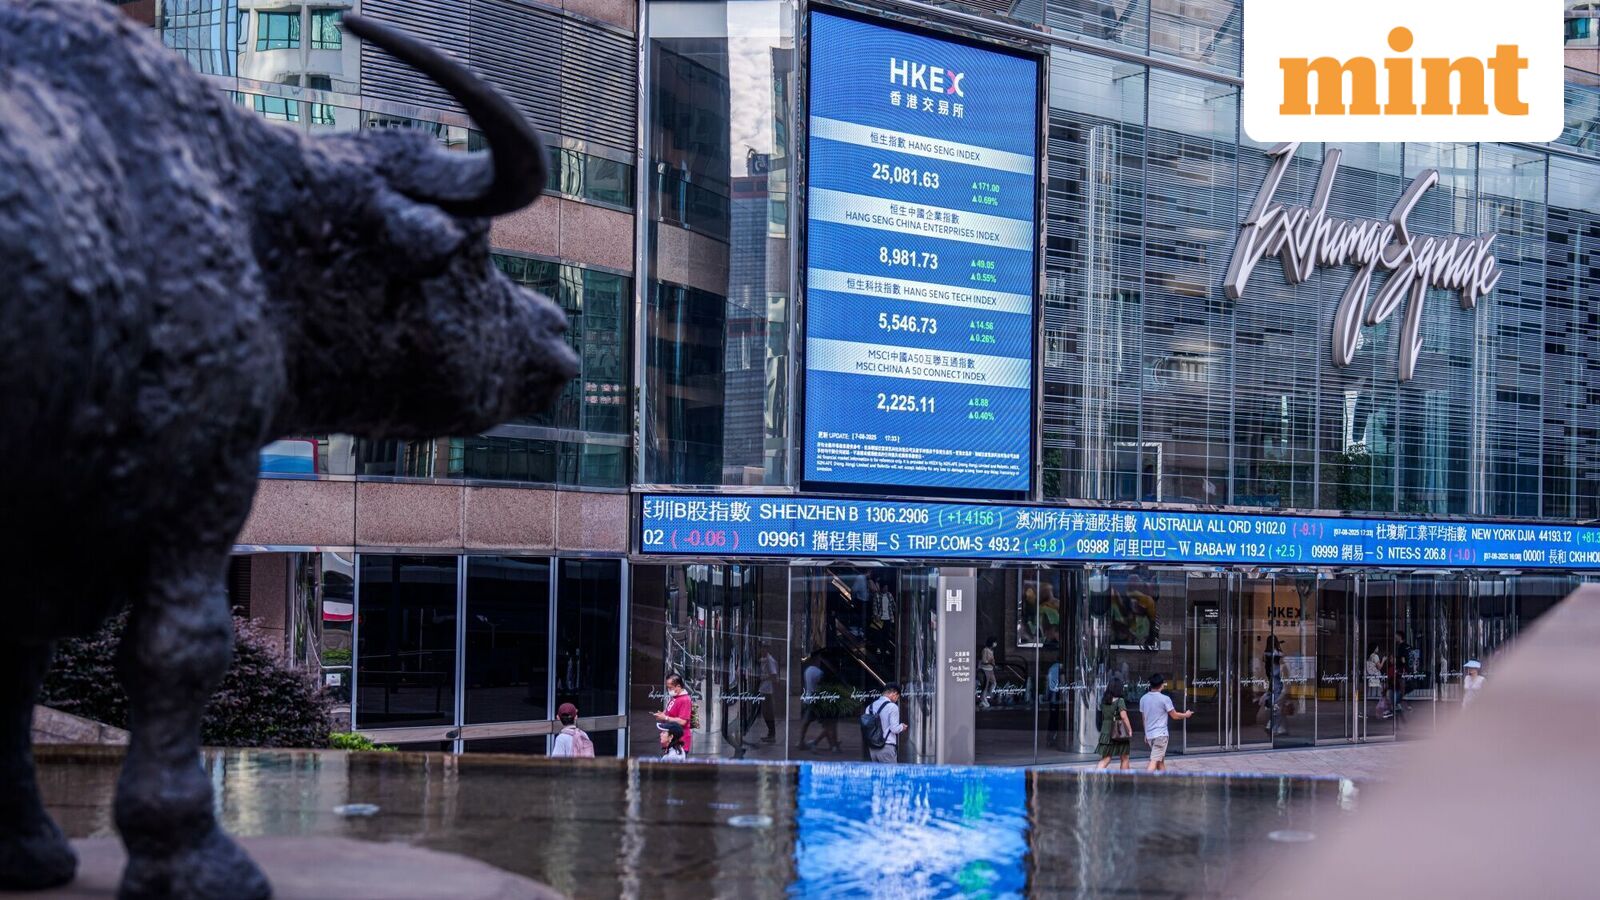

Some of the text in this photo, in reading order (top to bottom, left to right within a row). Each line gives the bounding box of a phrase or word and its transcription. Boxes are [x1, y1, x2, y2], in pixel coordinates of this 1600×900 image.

[890, 58, 964, 97] HKEX
[890, 91, 964, 119] 香港交易所
[870, 131, 981, 161] 恒生指數 HANG SENG INDEX
[872, 162, 940, 189] 25,081.63
[846, 210, 1000, 242] HANG SENG CHINA ENTERPRISES INDEX
[880, 247, 939, 270] 8,981.73
[1364, 168, 1502, 381] Square
[904, 286, 928, 298] HANG
[929, 289, 950, 300] SENG
[952, 292, 972, 304] TECH
[974, 295, 997, 306] INDEX
[878, 312, 938, 335] 5,546.73
[856, 362, 986, 381] MSCI CHINA A 50 CONNECT INDEX
[877, 393, 935, 413] 2,225.11
[760, 504, 846, 521] SHENZHEN
[850, 506, 859, 521] B
[866, 507, 929, 524] 1306.2906
[1016, 510, 1137, 533] 澳洲所有普通股指數
[1143, 518, 1204, 532] AUSTRALIA
[1208, 520, 1225, 533] ALL
[1229, 520, 1252, 533] ORD
[1256, 521, 1286, 535] 9102.0
[1376, 523, 1467, 542] 杜瓊斯工業平均指數
[1472, 529, 1491, 540] NEW
[1493, 529, 1517, 541] YORK
[1518, 530, 1536, 542] DJIA
[1539, 530, 1572, 543] 44193.12
[758, 531, 805, 547] 09961
[907, 534, 983, 551] TRIP.COM-S
[988, 536, 1020, 552] 493.2
[1077, 539, 1110, 554] 09988
[1194, 542, 1237, 557] BABA-W
[1241, 544, 1265, 557] 119.2
[1311, 544, 1339, 558] 09999
[1388, 547, 1421, 560] NTES-S
[1424, 547, 1446, 561] 206.8
[1523, 550, 1545, 562] 00001
[1548, 549, 1567, 565] 長和
[1570, 552, 1587, 563] CKH
